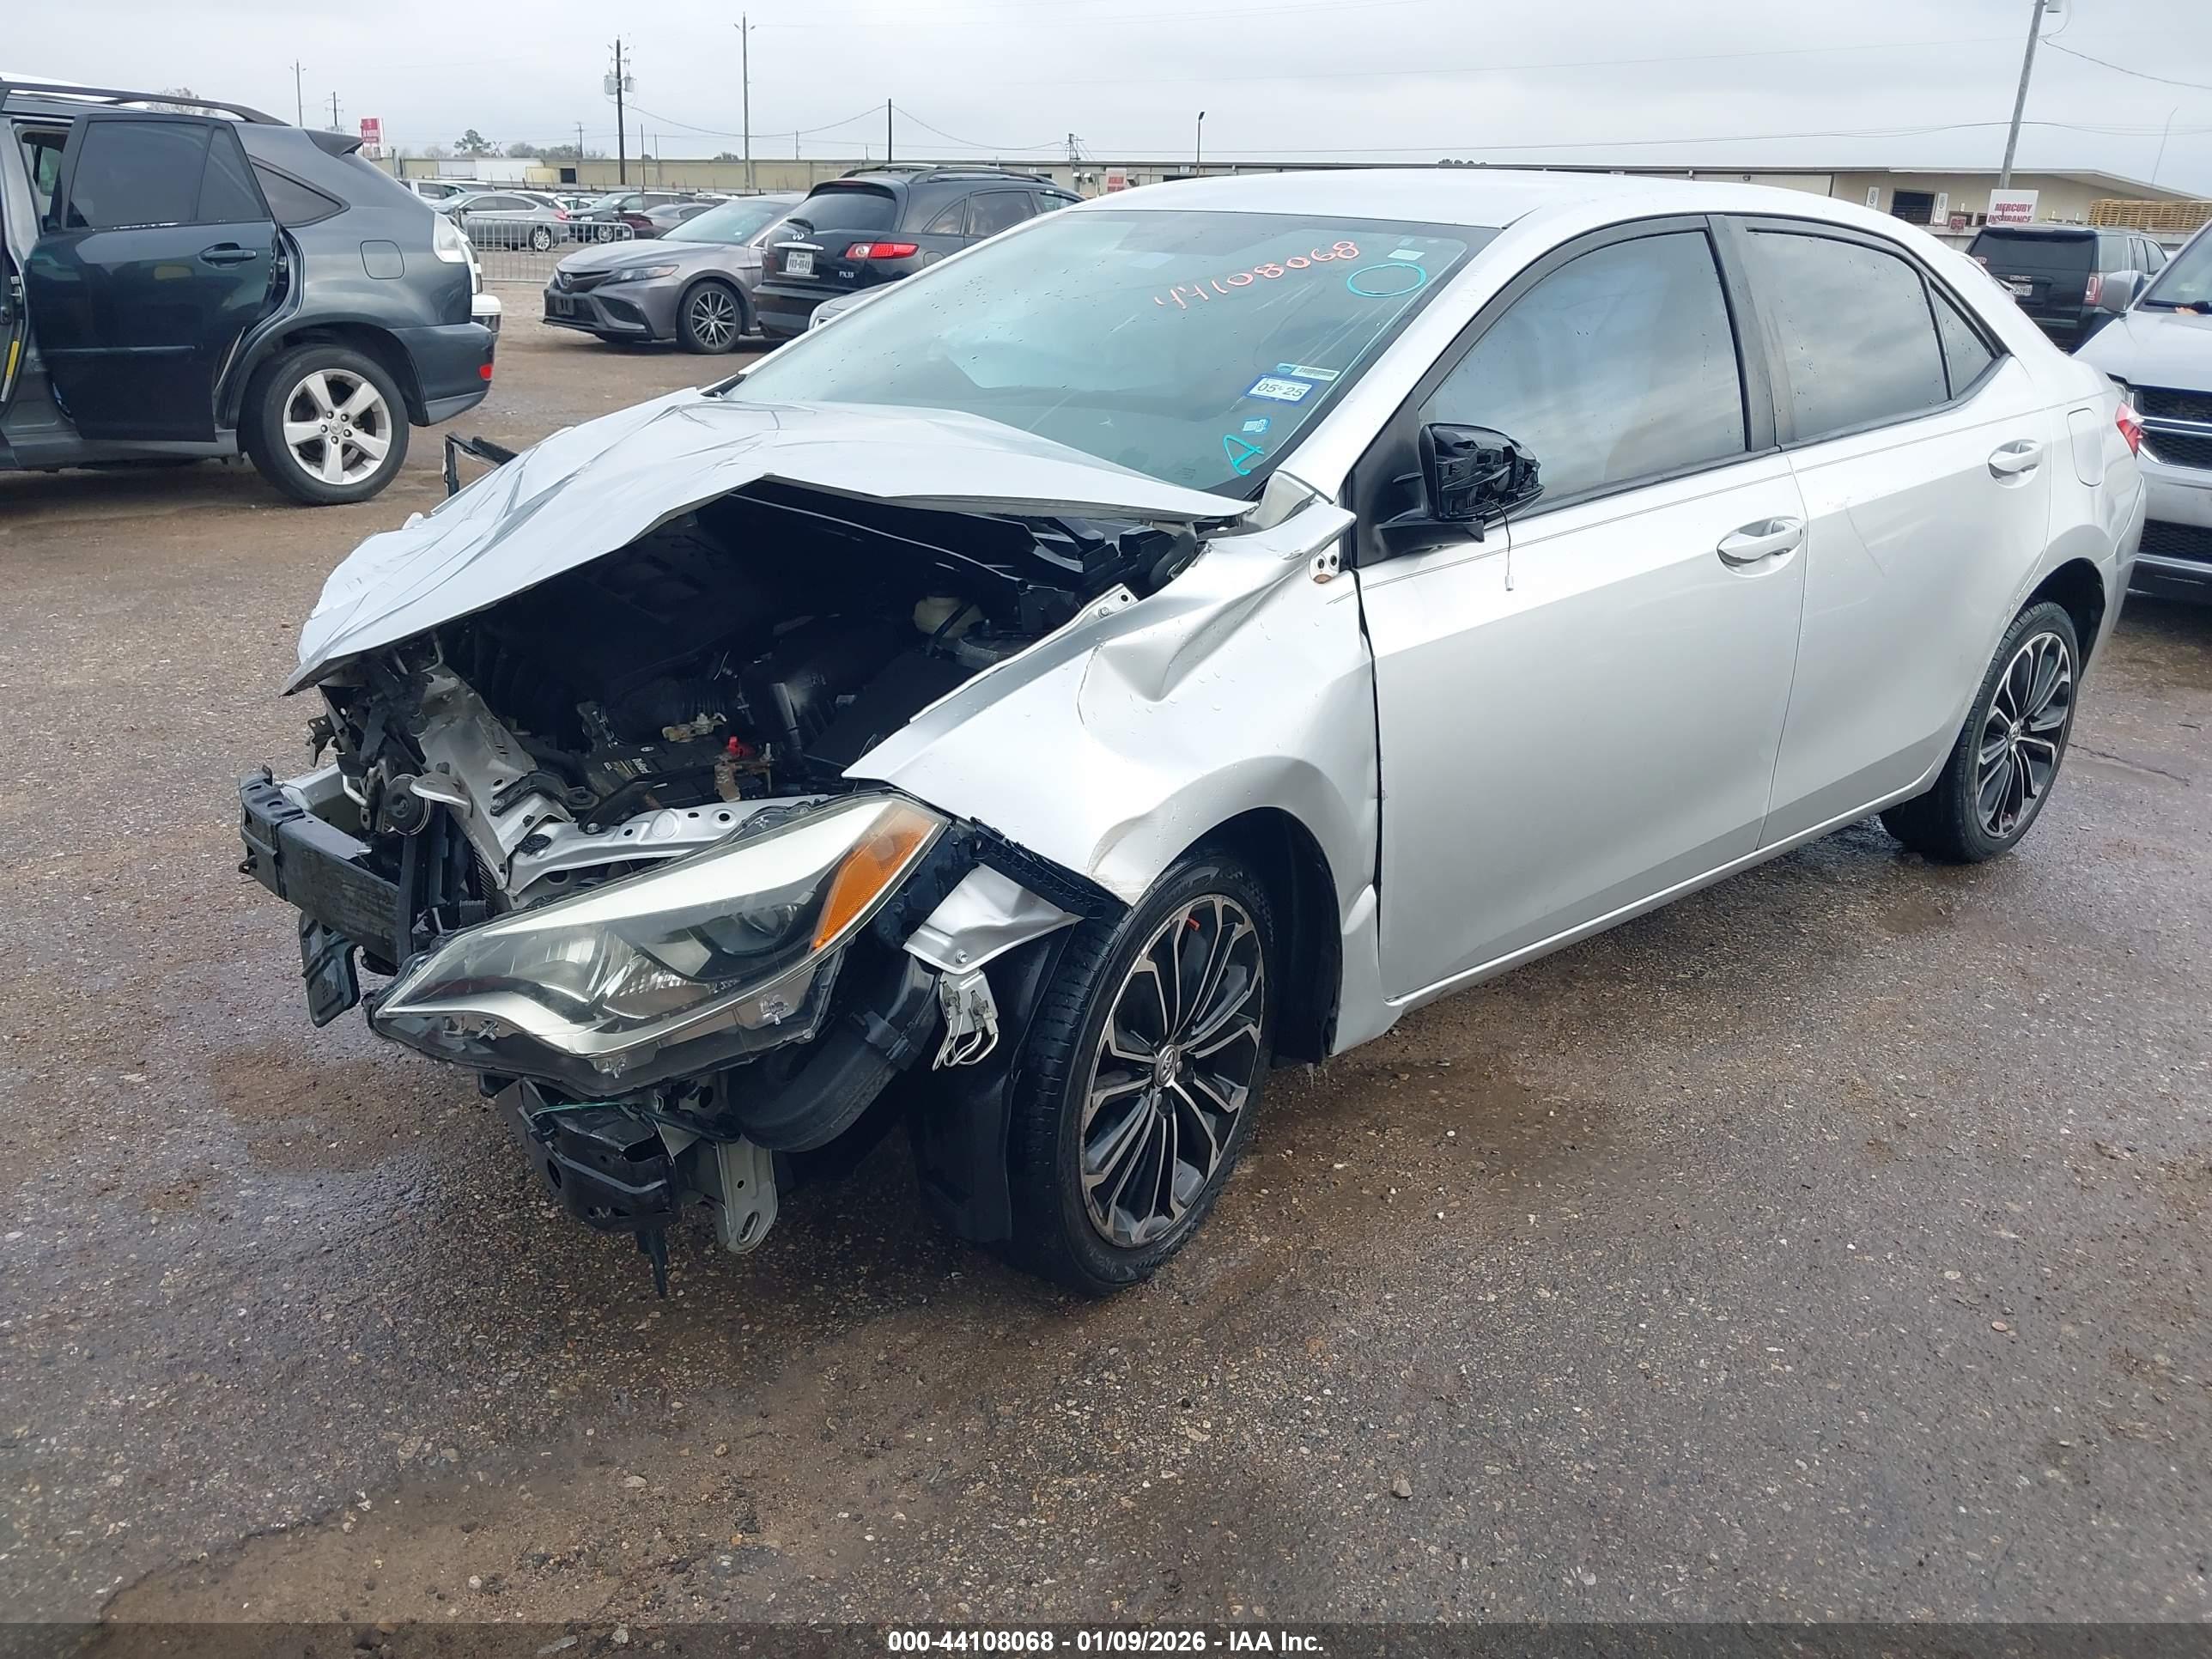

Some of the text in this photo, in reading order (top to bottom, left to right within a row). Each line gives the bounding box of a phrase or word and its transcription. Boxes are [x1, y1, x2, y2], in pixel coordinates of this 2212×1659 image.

[1995, 204, 2033, 212] MERCURY
[1988, 215, 2032, 223] INSURANCE
[1153, 240, 1360, 310] 44108068
[1256, 382, 1306, 398] 05 25
[1222, 434, 1265, 477] A
